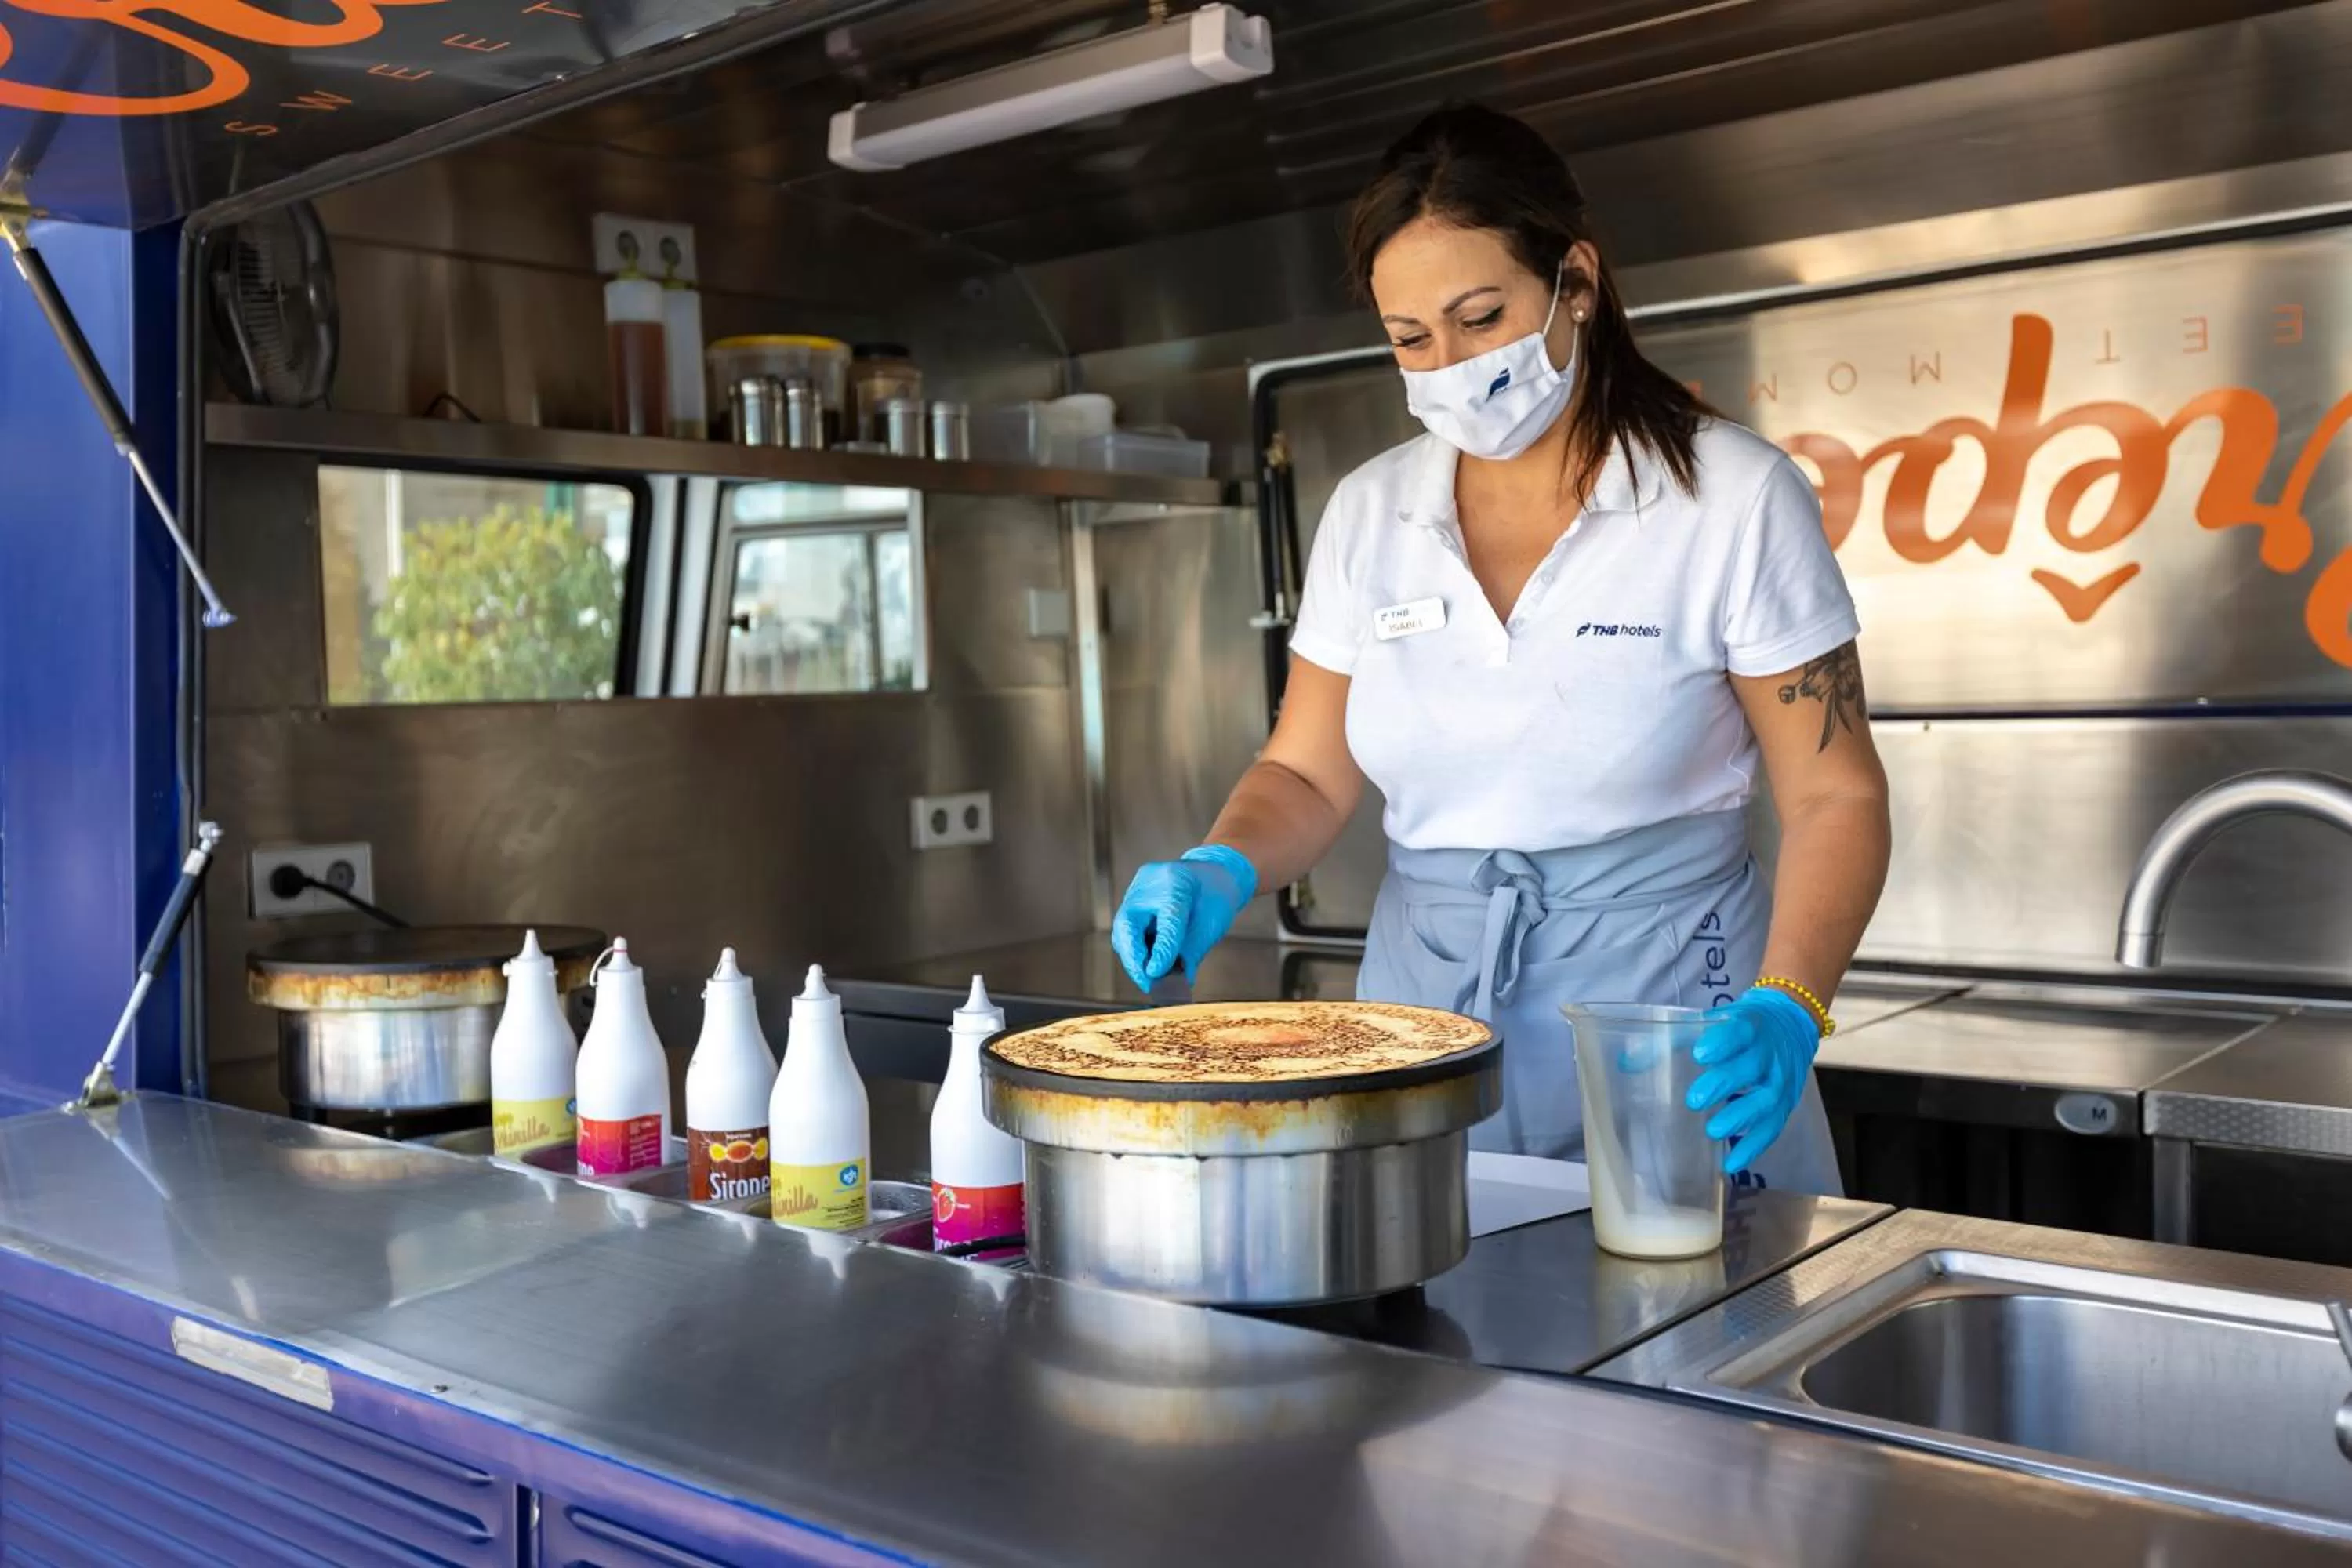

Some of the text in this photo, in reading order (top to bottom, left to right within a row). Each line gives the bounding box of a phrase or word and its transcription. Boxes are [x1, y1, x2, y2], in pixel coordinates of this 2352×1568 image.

[223, 1, 583, 136] SWEET
[1687, 350, 1941, 405] MOM
[1592, 622, 1662, 637] THB hotels
[1693, 911, 1735, 1011] otels
